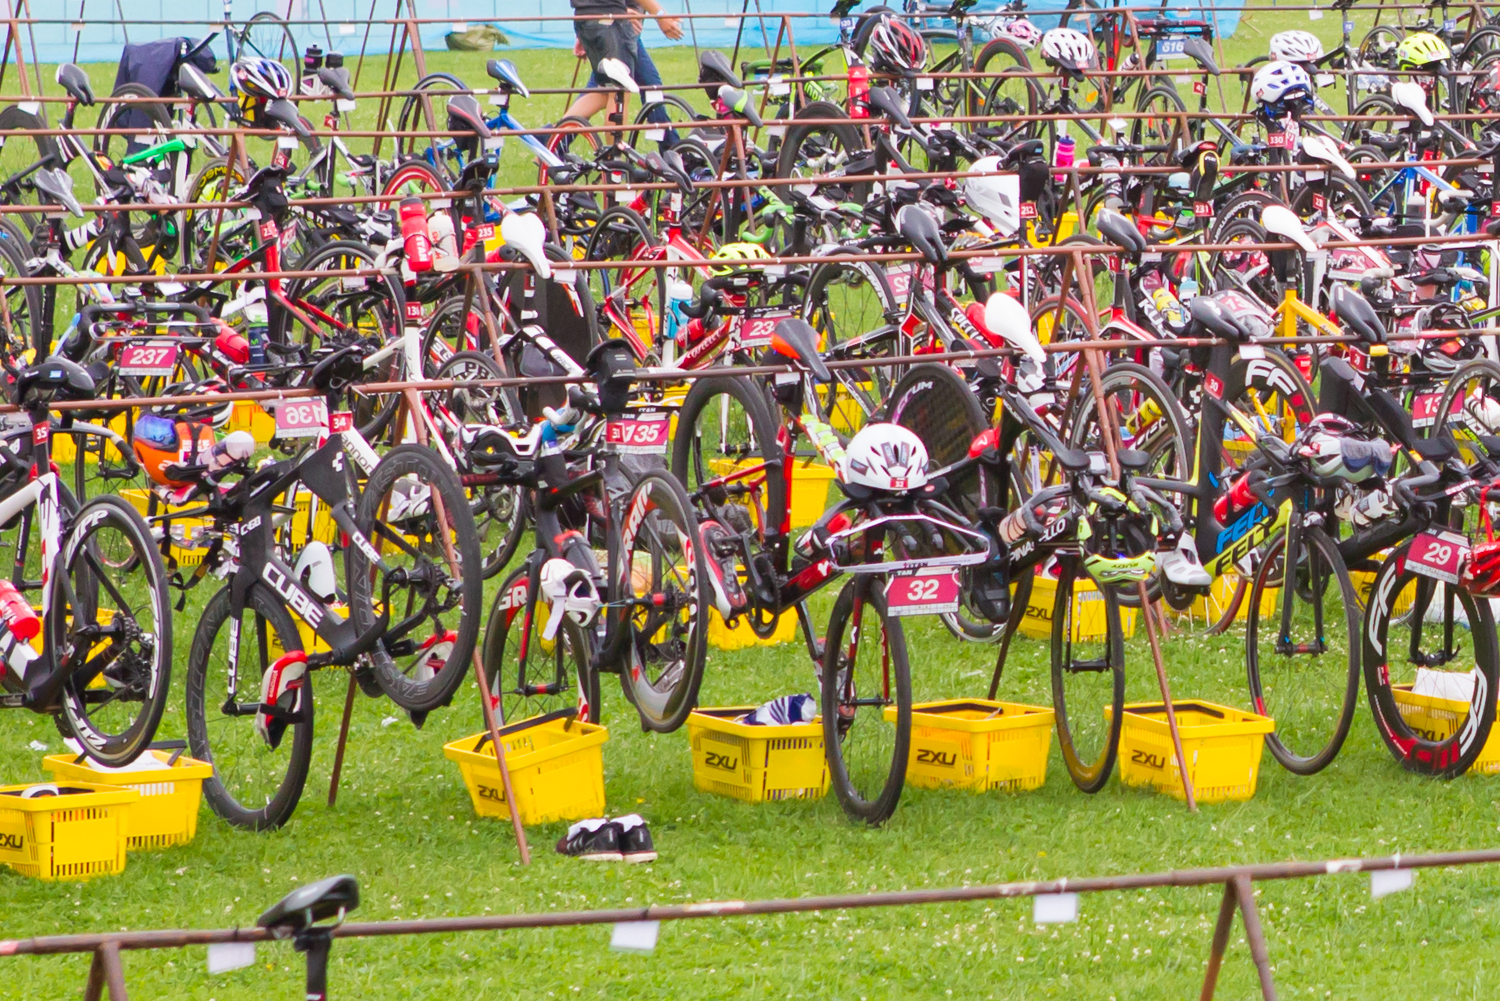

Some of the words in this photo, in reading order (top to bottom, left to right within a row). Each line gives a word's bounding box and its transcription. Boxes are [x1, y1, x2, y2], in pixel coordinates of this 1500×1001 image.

[129, 349, 169, 365] 237
[333, 417, 346, 429] 34
[625, 423, 660, 443] 135
[37, 427, 47, 440] 35
[352, 530, 381, 564] CUBE
[1422, 542, 1453, 566] 29
[262, 561, 325, 630] CUBE
[907, 579, 940, 601] 32
[228, 616, 240, 694] CUBE
[705, 751, 738, 770] 2XU
[917, 748, 957, 767] 2XU
[1131, 749, 1166, 769] 2XU
